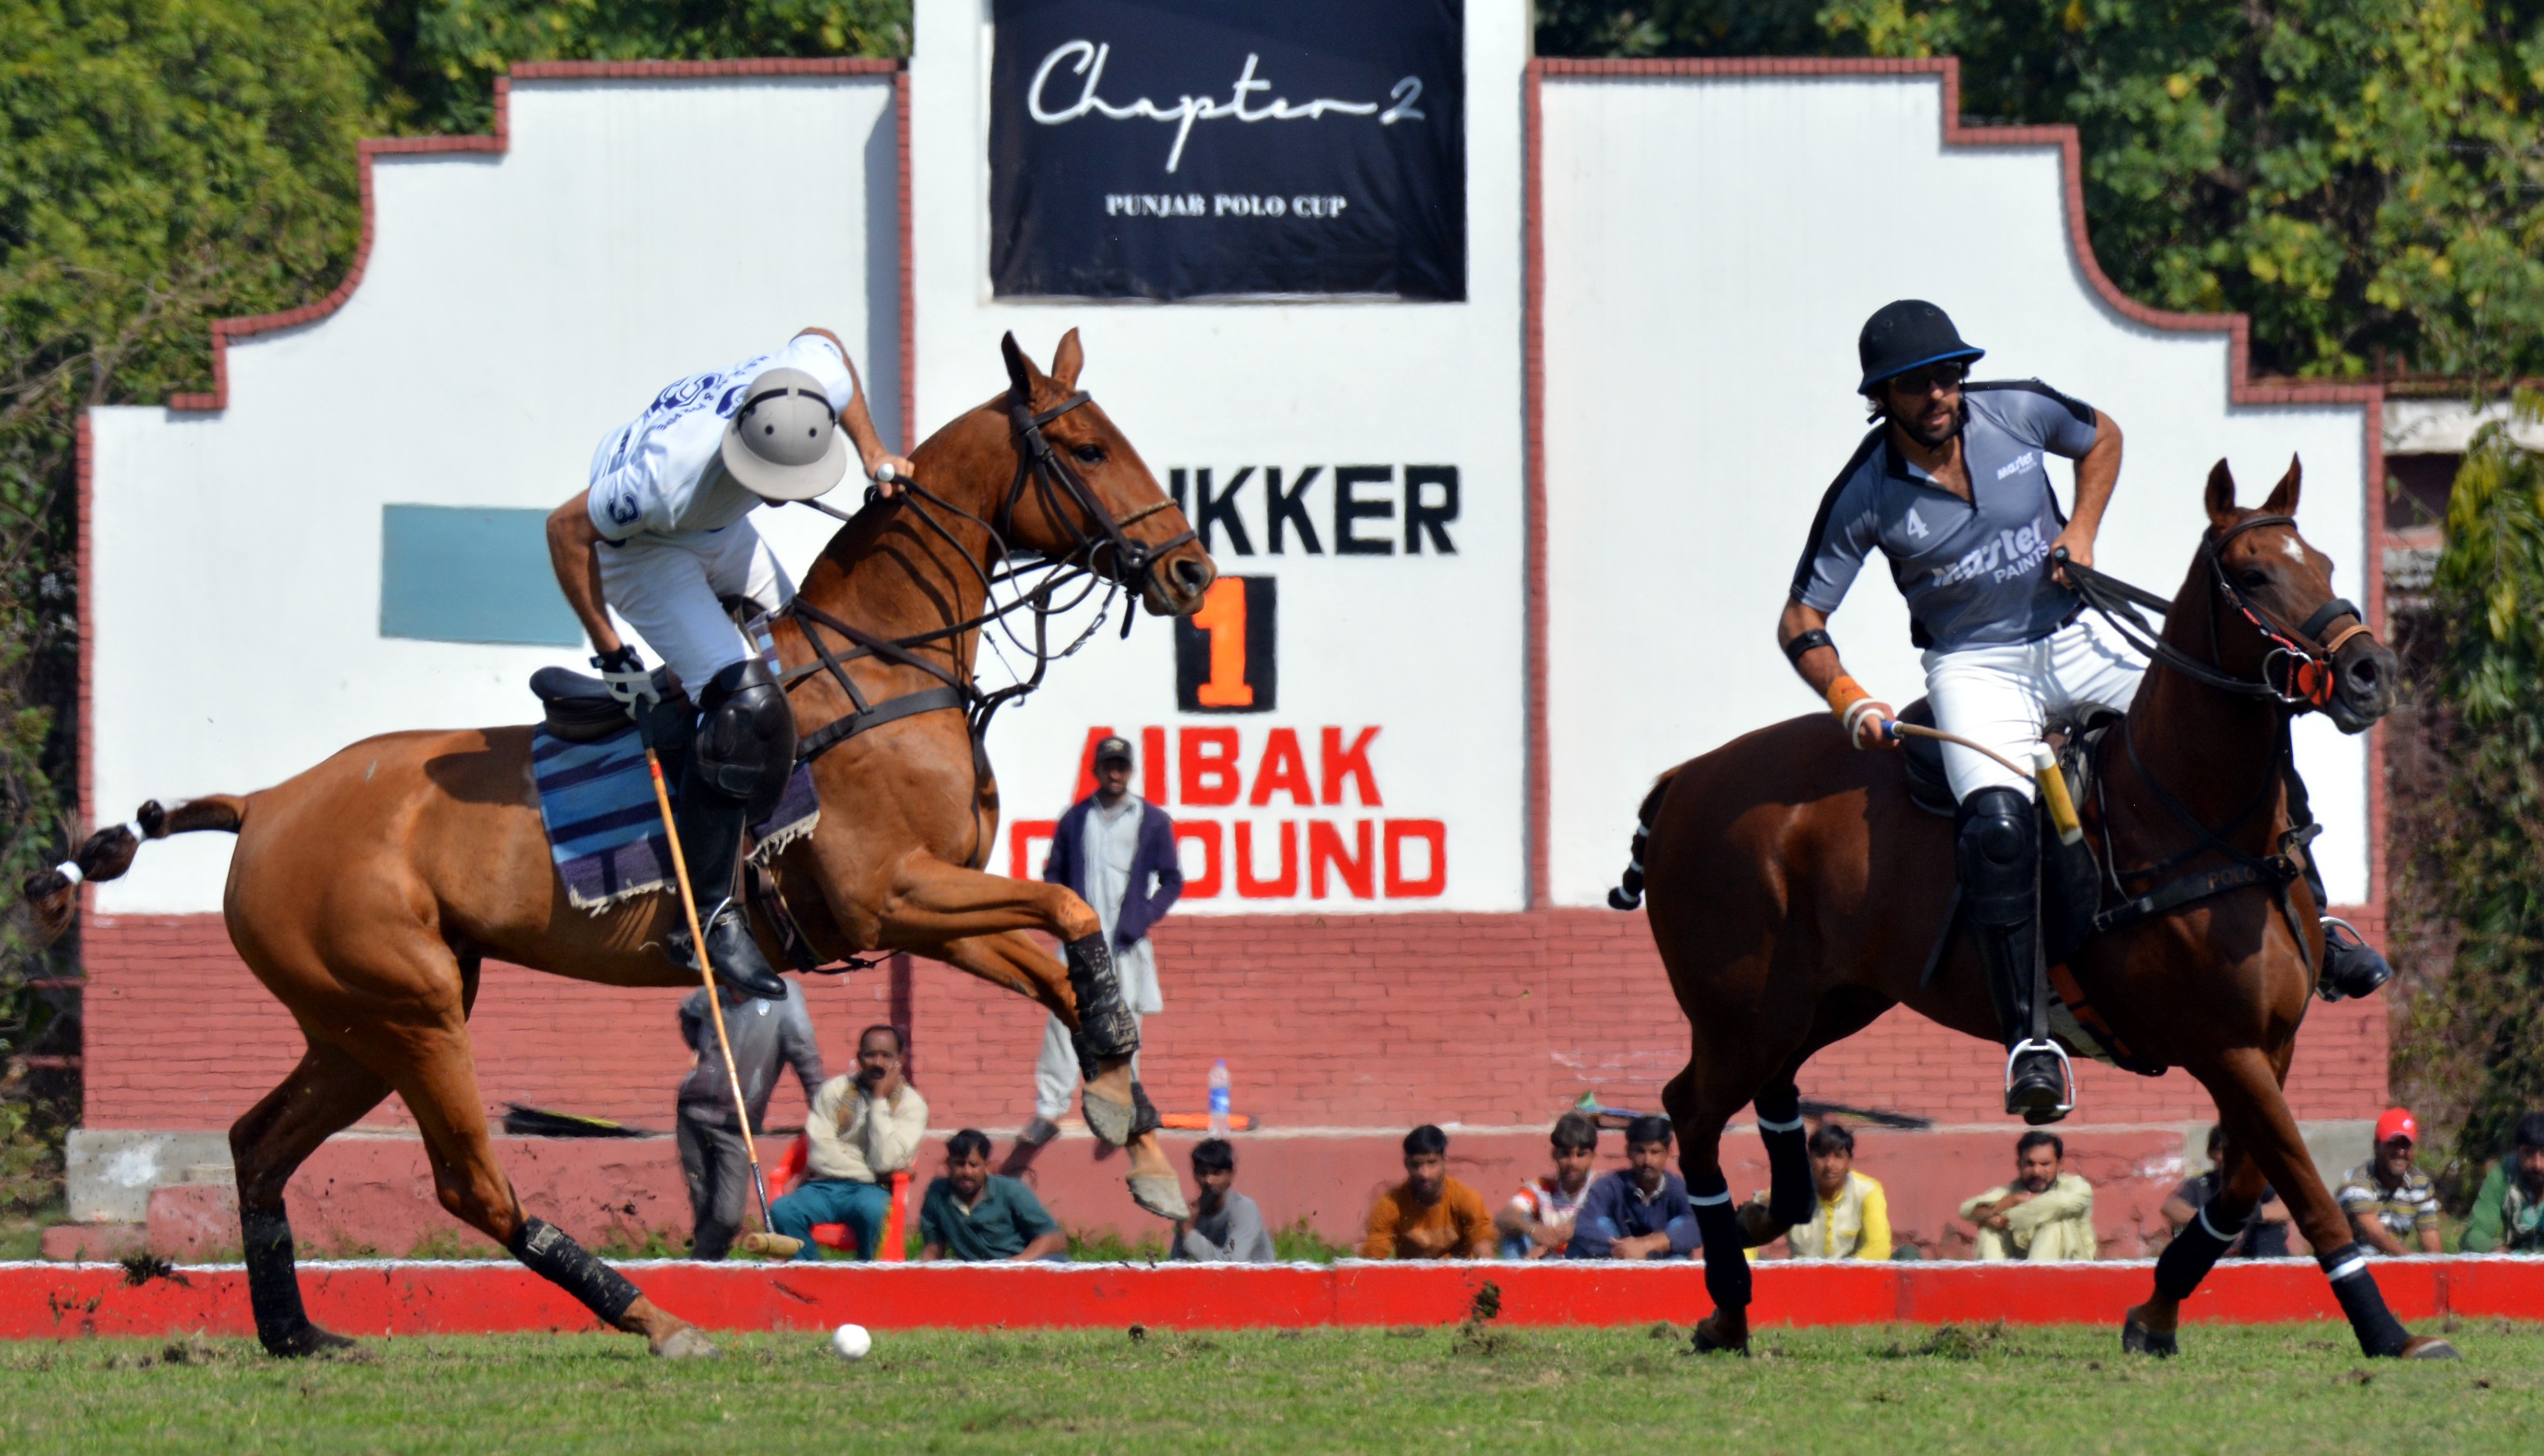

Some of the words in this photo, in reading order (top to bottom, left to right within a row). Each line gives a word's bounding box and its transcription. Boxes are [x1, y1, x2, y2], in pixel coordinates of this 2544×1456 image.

[1028, 38, 1378, 174] Chapter
[1379, 75, 1425, 126] 2
[1105, 193, 1206, 217] PUNJAB
[1214, 193, 1287, 217] POLO
[1292, 194, 1347, 218] CUP
[606, 493, 642, 527] 3
[1907, 508, 1930, 539] 4
[1992, 539, 2050, 584] PAINTS
[1191, 575, 1255, 708] 1
[1008, 818, 1447, 900] GOUND
